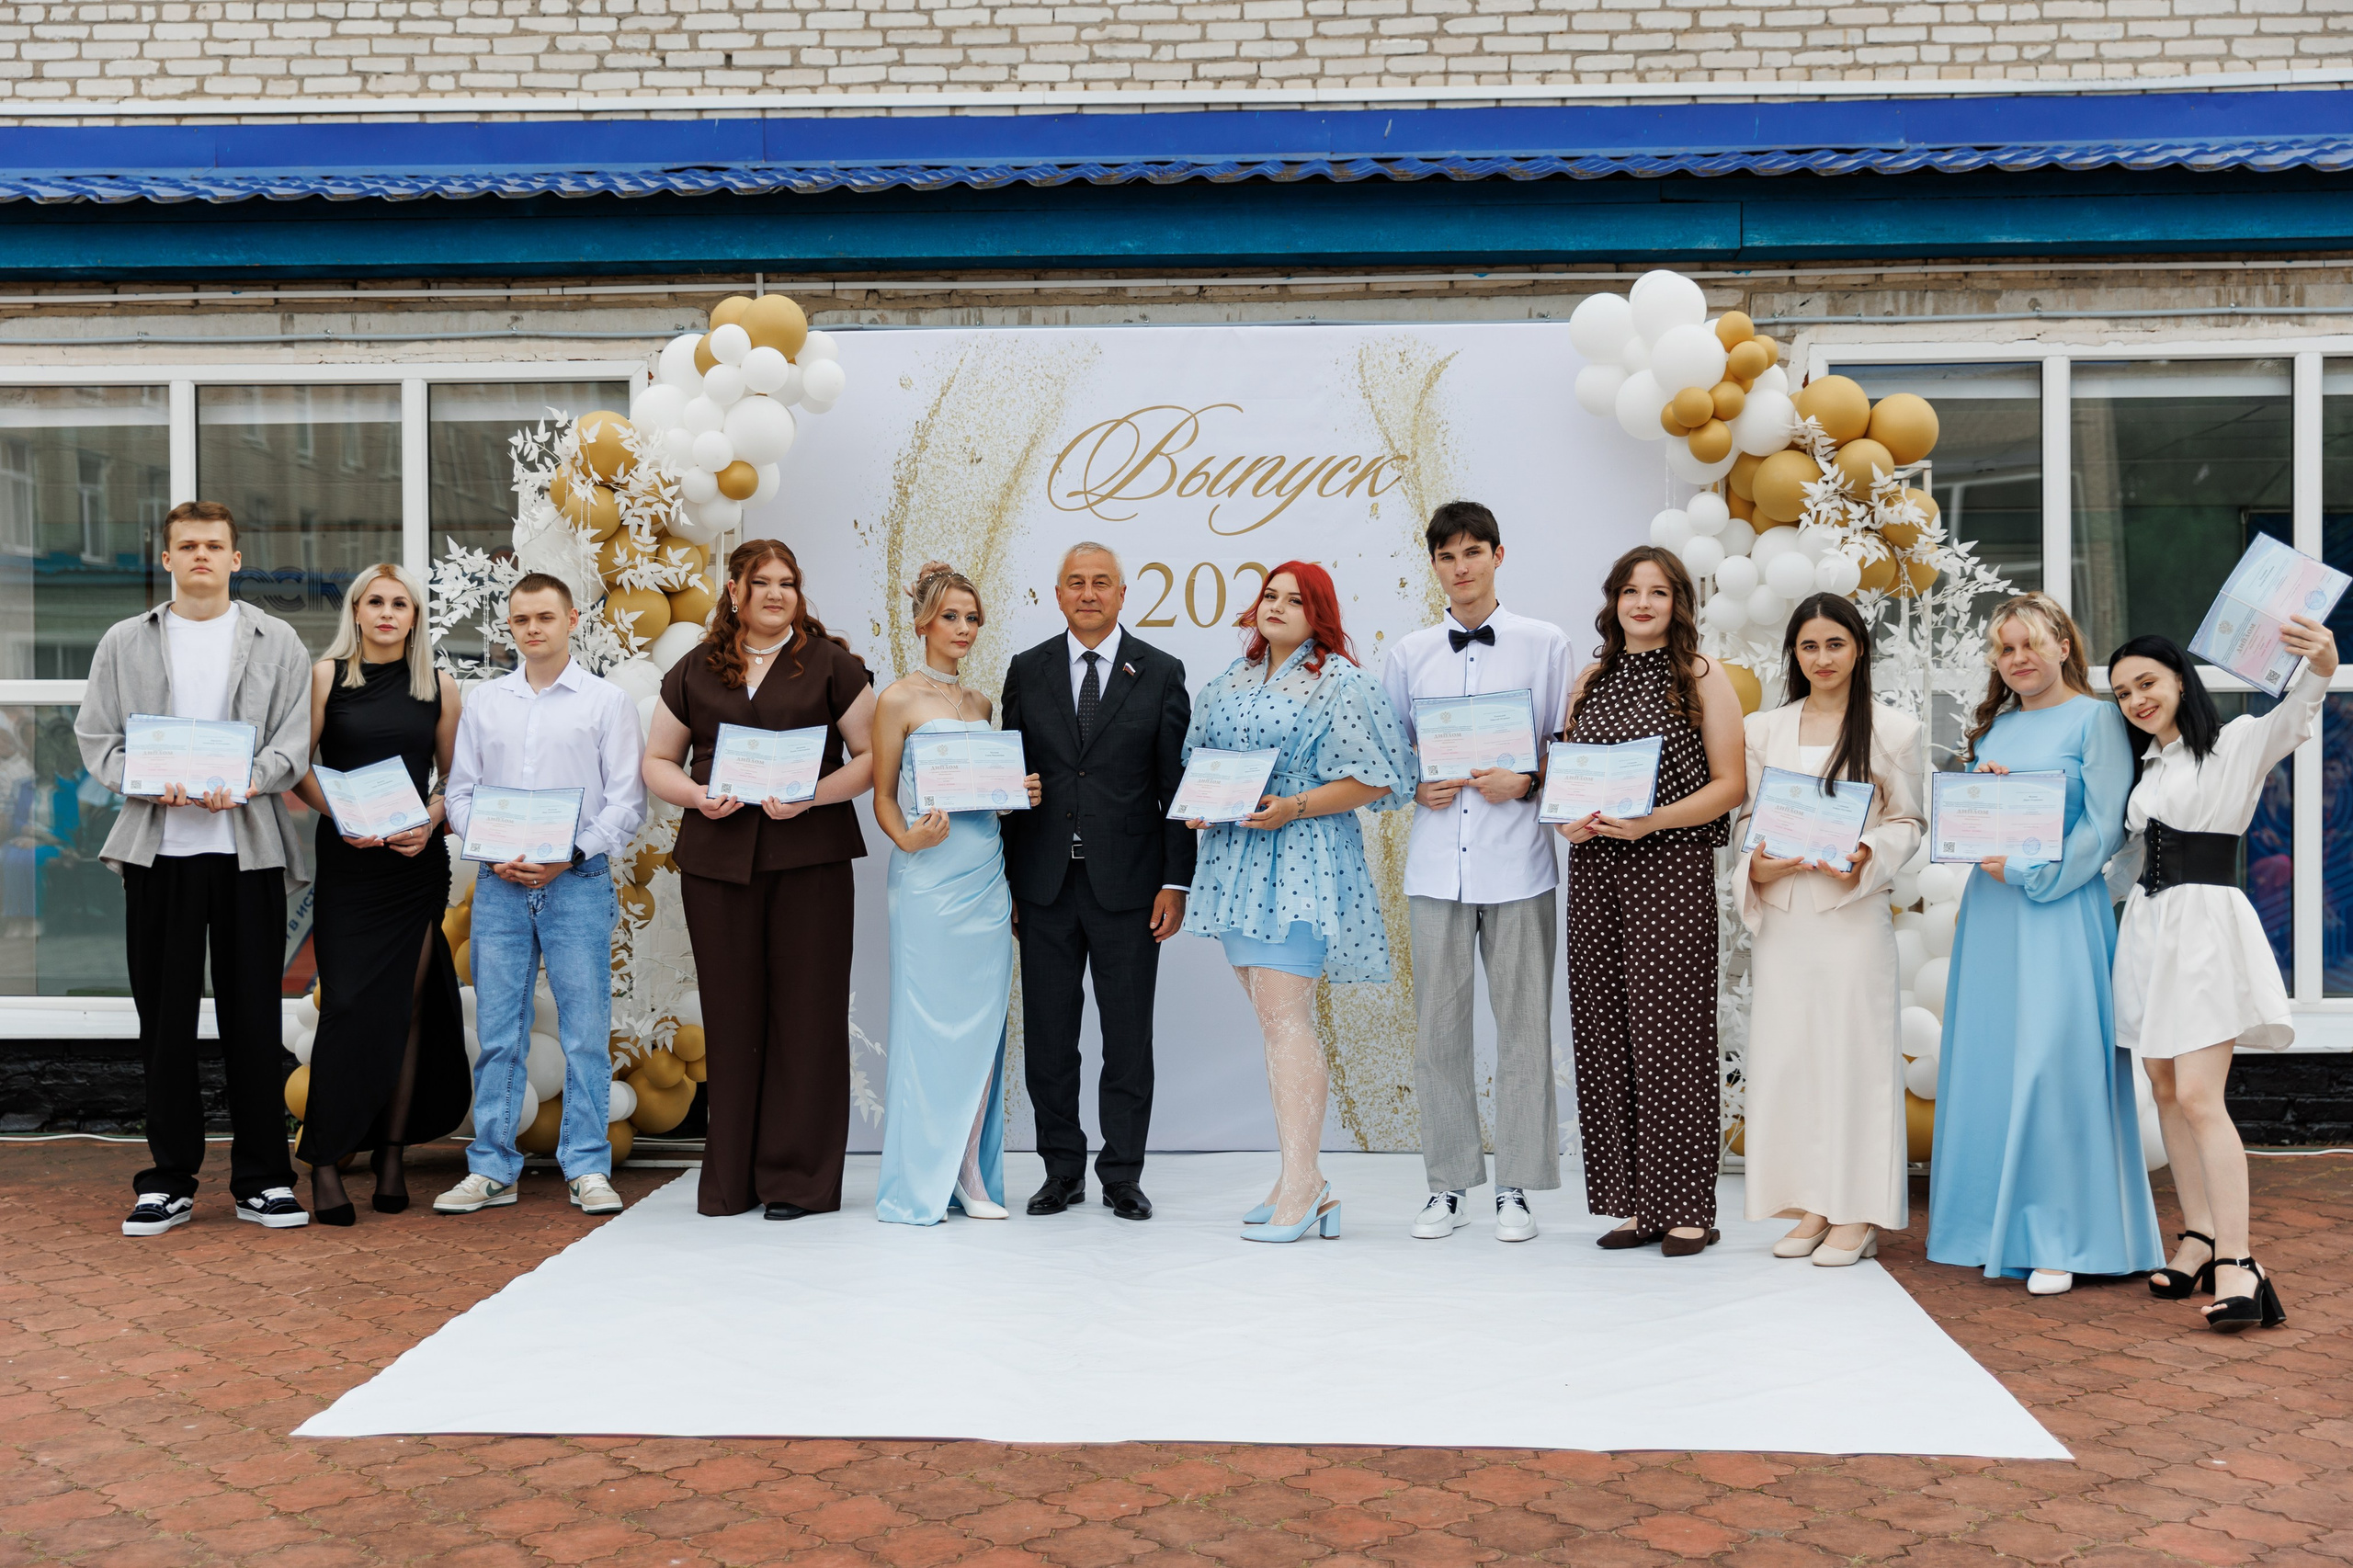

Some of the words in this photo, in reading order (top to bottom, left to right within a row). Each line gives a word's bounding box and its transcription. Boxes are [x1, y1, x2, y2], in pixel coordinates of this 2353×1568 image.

[1048, 403, 1408, 536] Выпуск
[1135, 561, 1321, 629] 202
[2236, 623, 2257, 654] ДИПЛОМ
[736, 756, 765, 766] ДИПЛОМ
[1775, 804, 1804, 816] ДИПЛОМ
[296, 887, 314, 918] ИСТ
